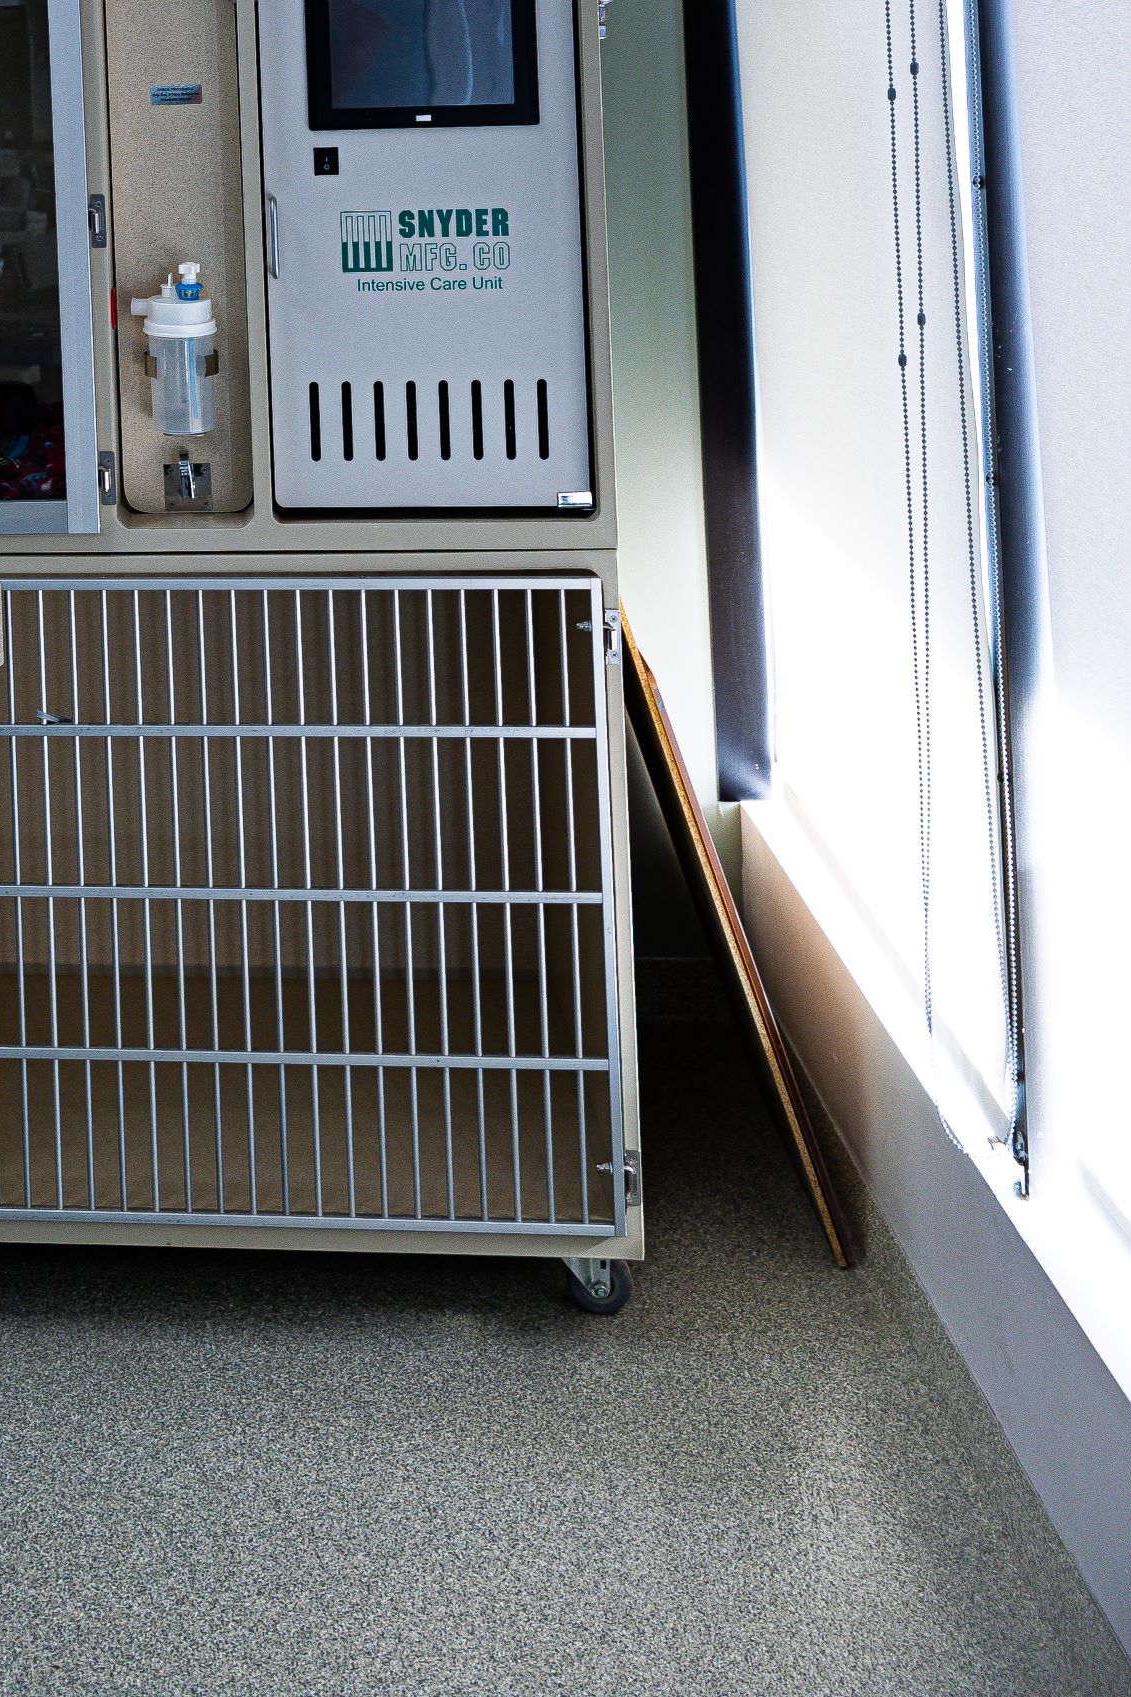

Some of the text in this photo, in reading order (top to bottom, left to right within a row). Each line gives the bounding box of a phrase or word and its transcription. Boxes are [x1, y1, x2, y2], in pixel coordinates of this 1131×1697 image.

[398, 208, 510, 239] SNYDER
[399, 241, 511, 272] MFG. CO
[357, 276, 503, 292] Intensive Care Unit
